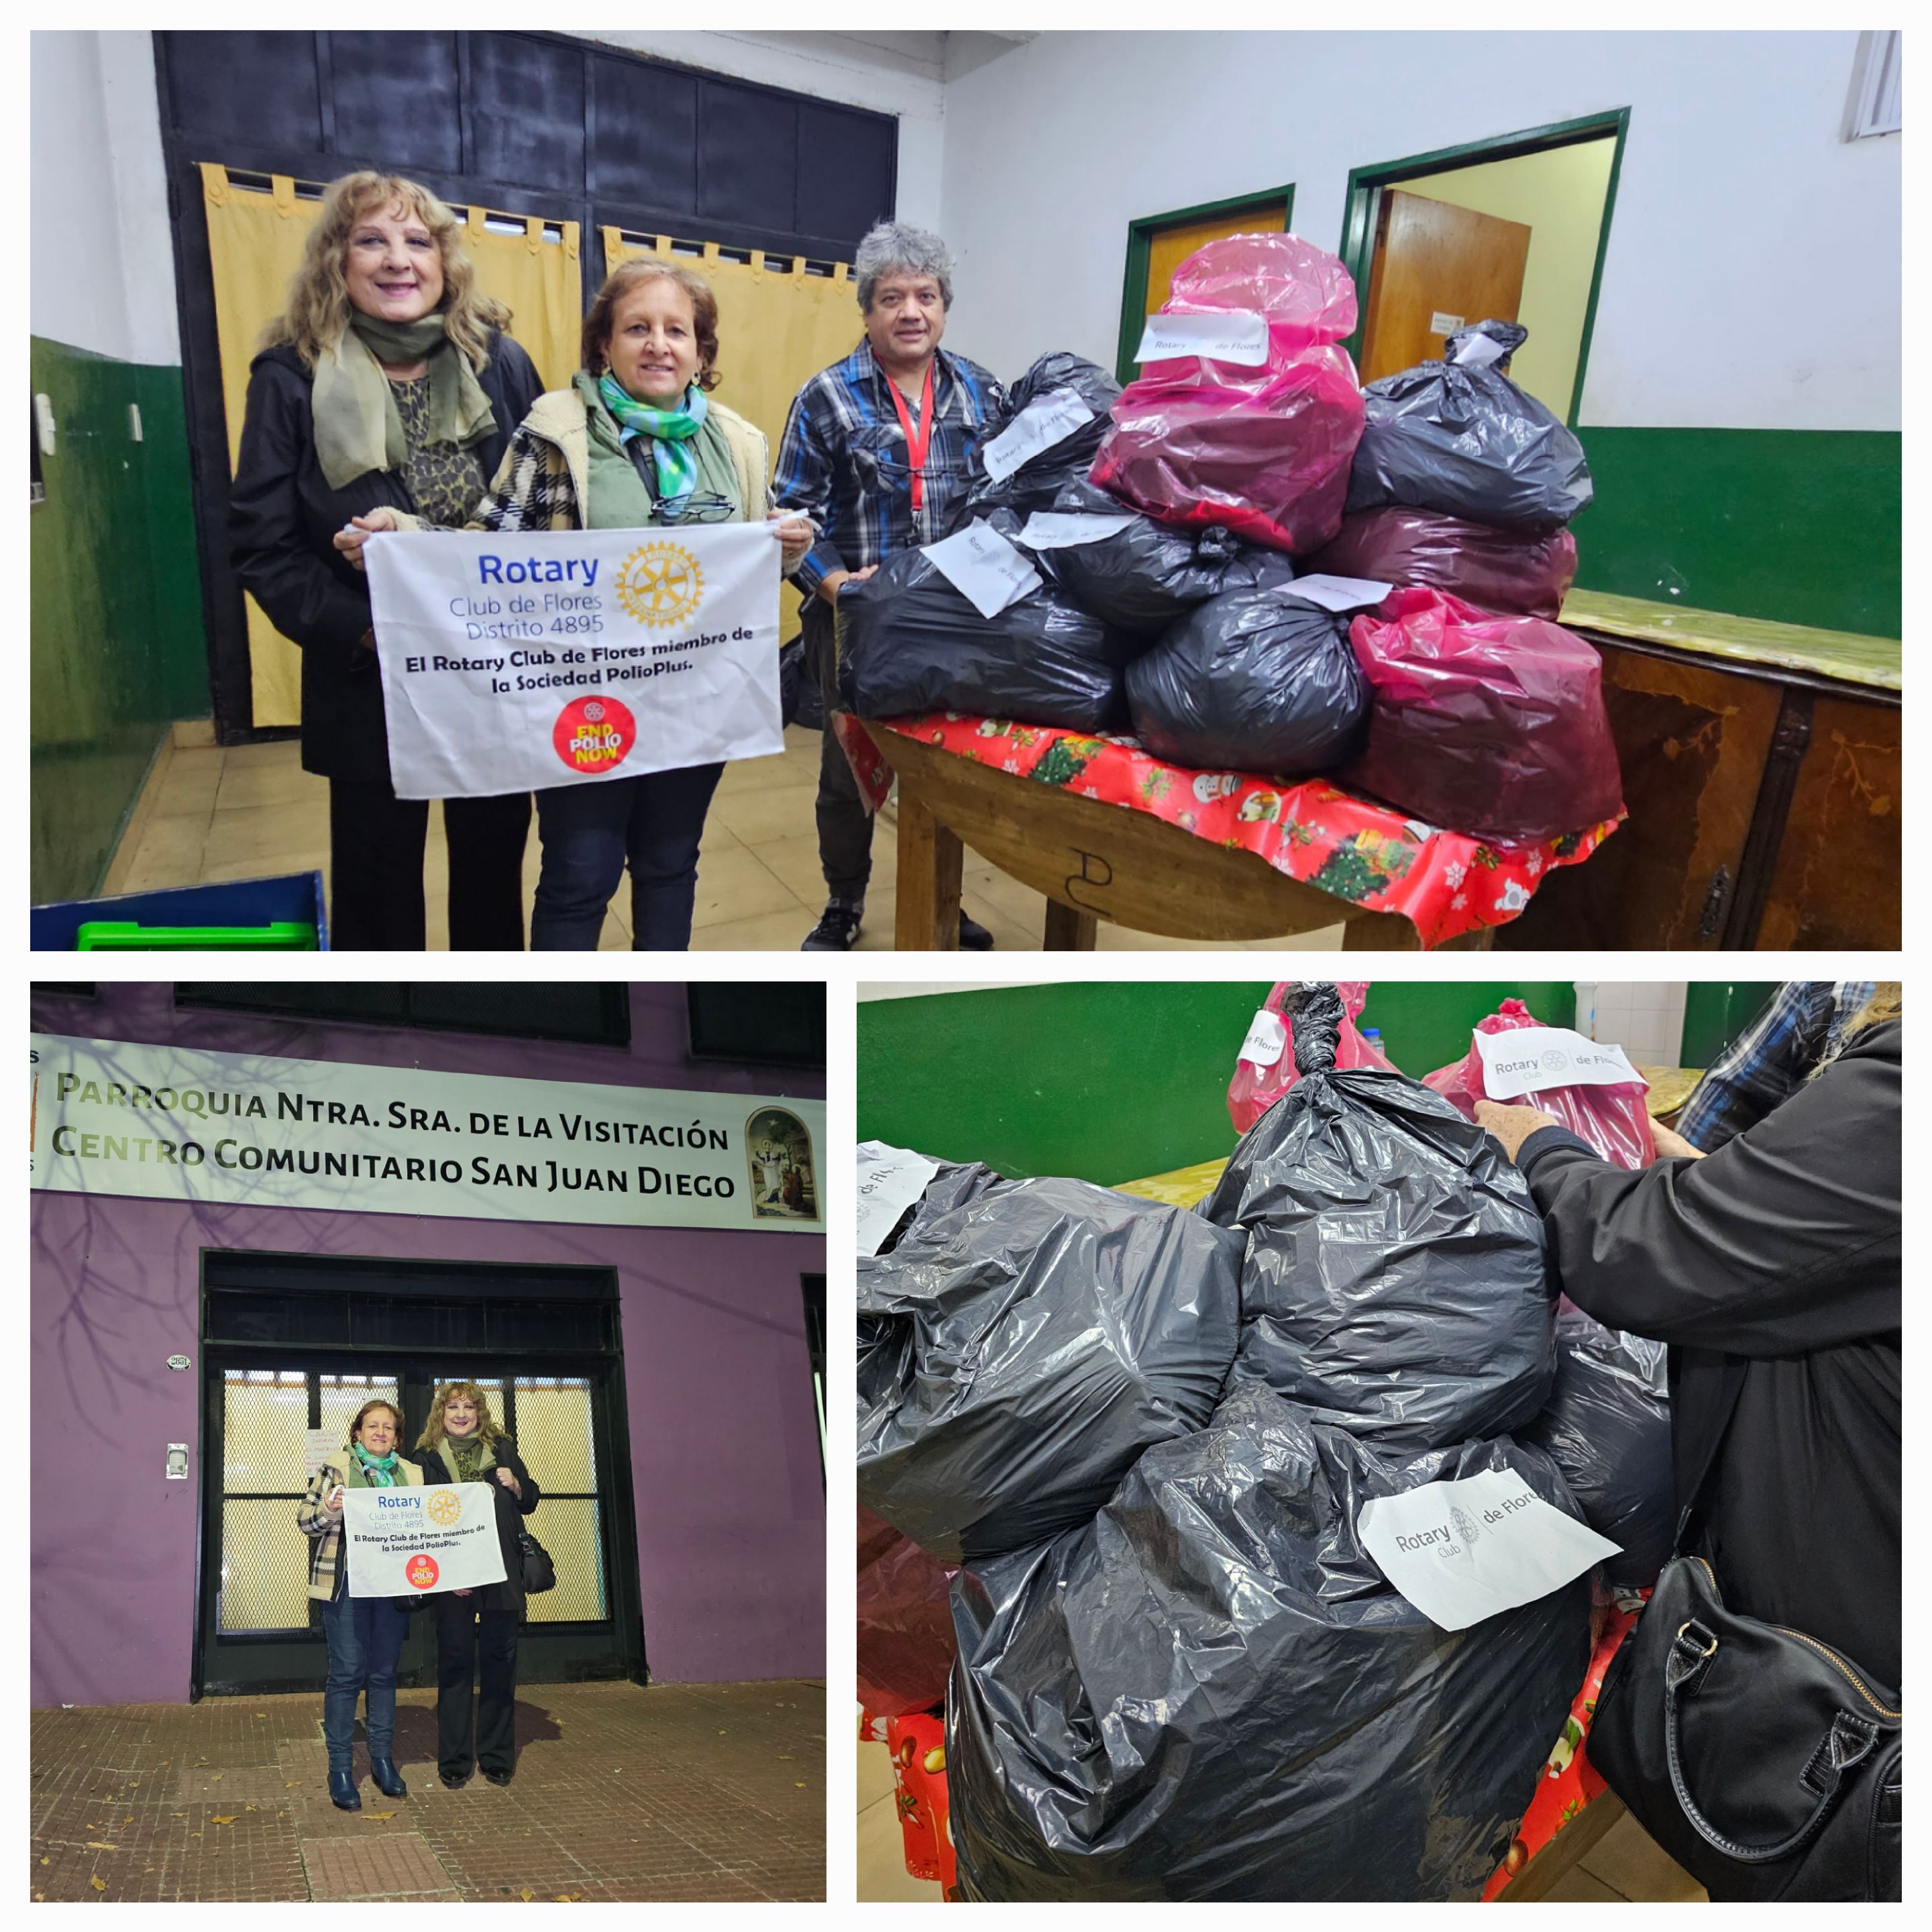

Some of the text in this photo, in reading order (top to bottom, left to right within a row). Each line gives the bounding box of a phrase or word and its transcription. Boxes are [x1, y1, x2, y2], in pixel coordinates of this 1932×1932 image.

[1155, 340, 1187, 350] Rotary
[1230, 342, 1261, 350] Flores
[478, 555, 599, 587] Rotary
[449, 593, 602, 616] Club de Flores
[466, 614, 604, 640] Distrito 4895
[405, 627, 753, 672] El Rotary Club de Flores miembro de
[492, 660, 693, 693] la Sociedad PolioPlus.
[576, 723, 614, 739] END
[570, 733, 622, 753] POLIO
[576, 747, 617, 764] NOW
[1495, 1059, 1538, 1075] Rotary
[1576, 1055, 1591, 1065] de
[1523, 1071, 1542, 1080] Club
[470, 1112, 509, 1136] DE
[517, 1116, 552, 1139] LA
[171, 1356, 187, 1366] 2851
[378, 1496, 421, 1509] Rotary
[369, 1511, 423, 1521] Club de Flores
[374, 1519, 424, 1530] Distrito 4895
[354, 1523, 486, 1543] El Rotary Club de Flores miembro de
[1395, 1524, 1450, 1553] Rotary
[1483, 1509, 1504, 1523] de
[382, 1544, 390, 1552] la
[392, 1542, 425, 1552] Sociedad
[1438, 1544, 1461, 1558] Club
[412, 1572, 434, 1580] POLIO
